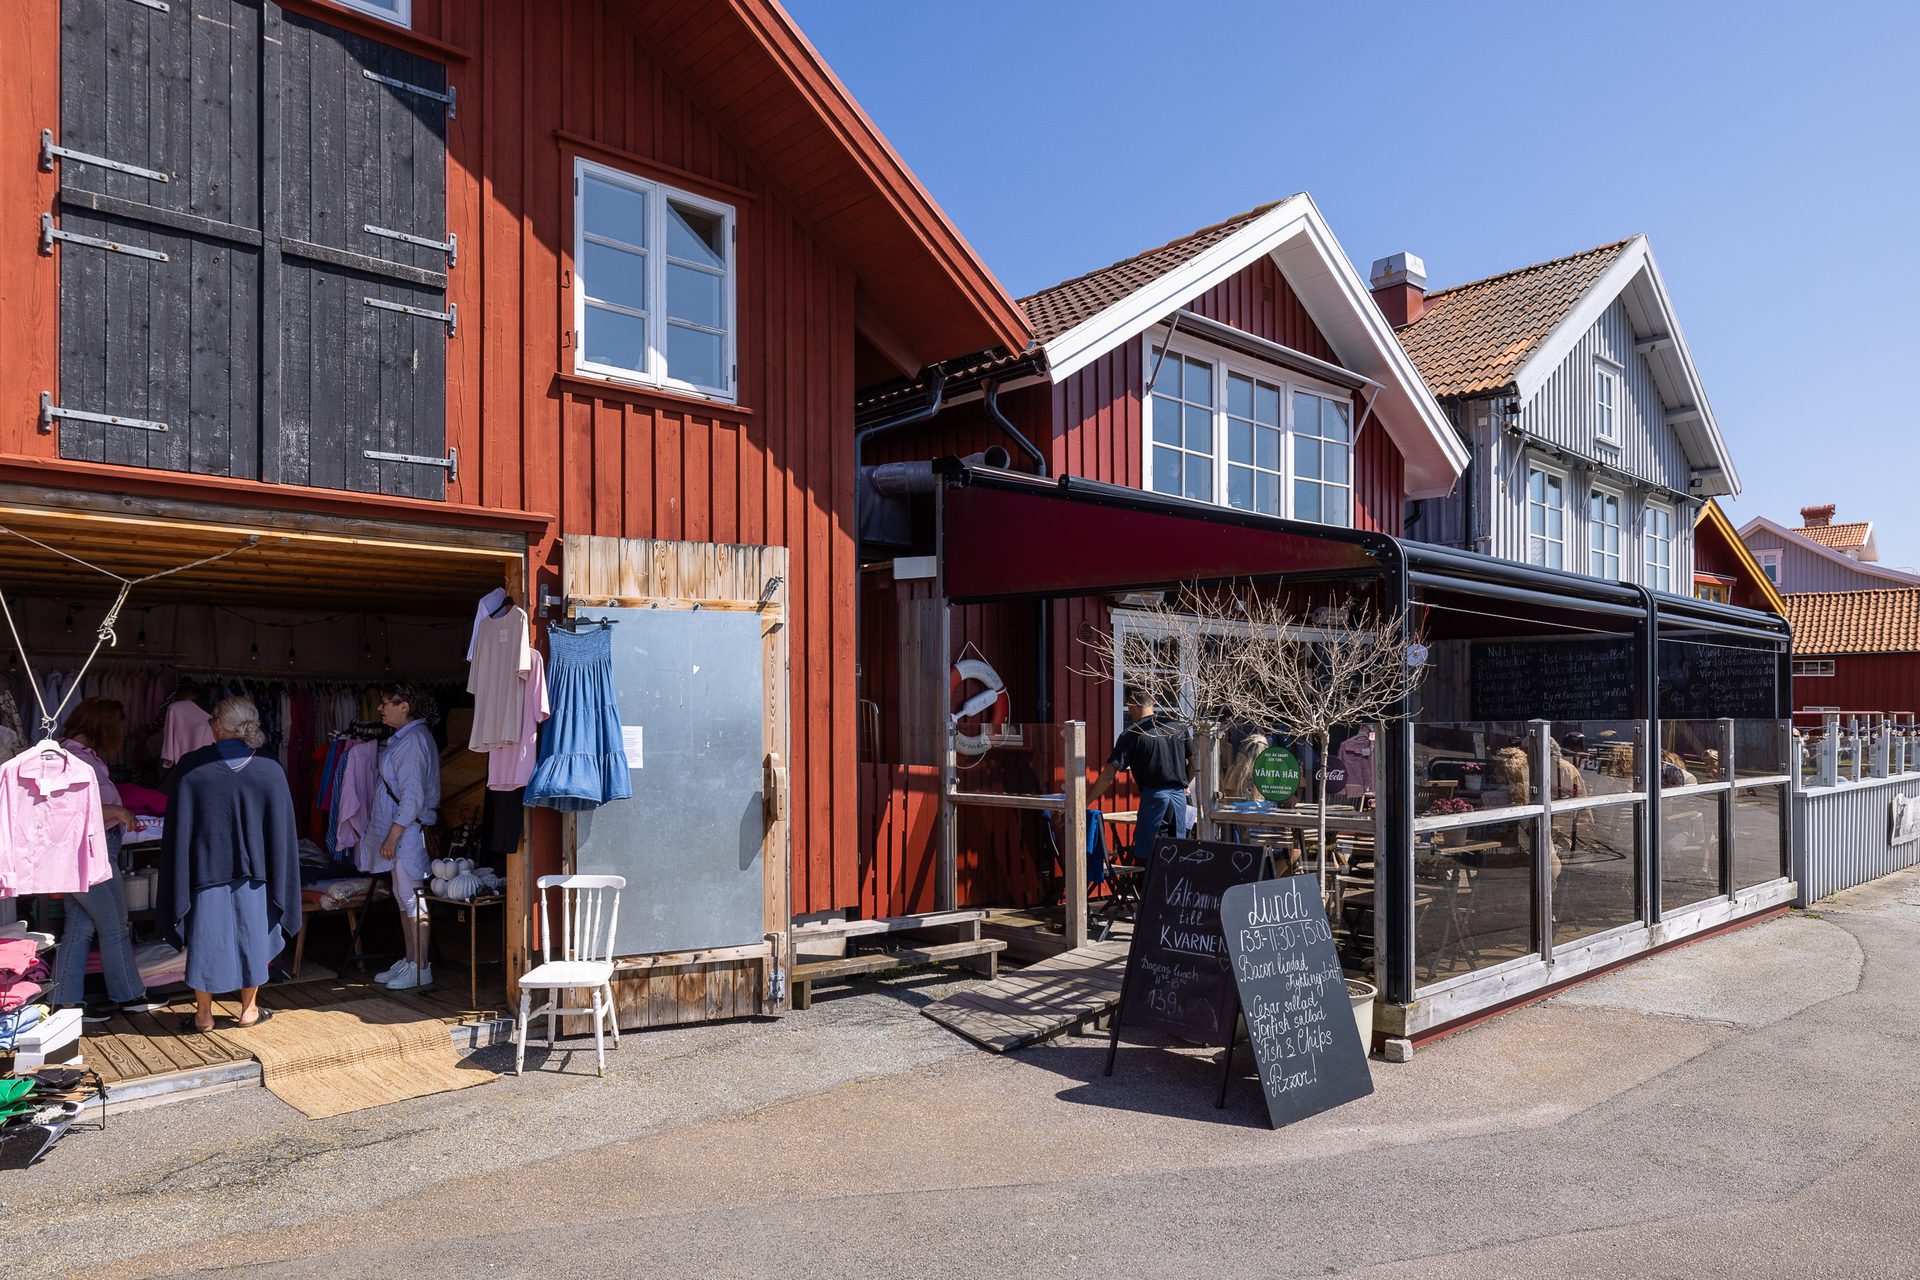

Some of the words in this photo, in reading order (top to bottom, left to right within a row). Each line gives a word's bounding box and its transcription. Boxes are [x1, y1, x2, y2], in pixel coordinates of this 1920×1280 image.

[1255, 768, 1280, 778] VÄNTA
[1282, 769, 1298, 778] HÄR
[1164, 873, 1220, 910] Välkomm
[1248, 878, 1309, 926] Lunch
[1179, 910, 1203, 926] till
[1141, 954, 1171, 975] Dagens
[1238, 954, 1276, 983] Bacon
[1284, 990, 1319, 1013] sallad
[1294, 1006, 1327, 1029] sallad
[1260, 1036, 1283, 1064] Fish
[1286, 1037, 1296, 1058] &
[1297, 1024, 1333, 1054] Chips
